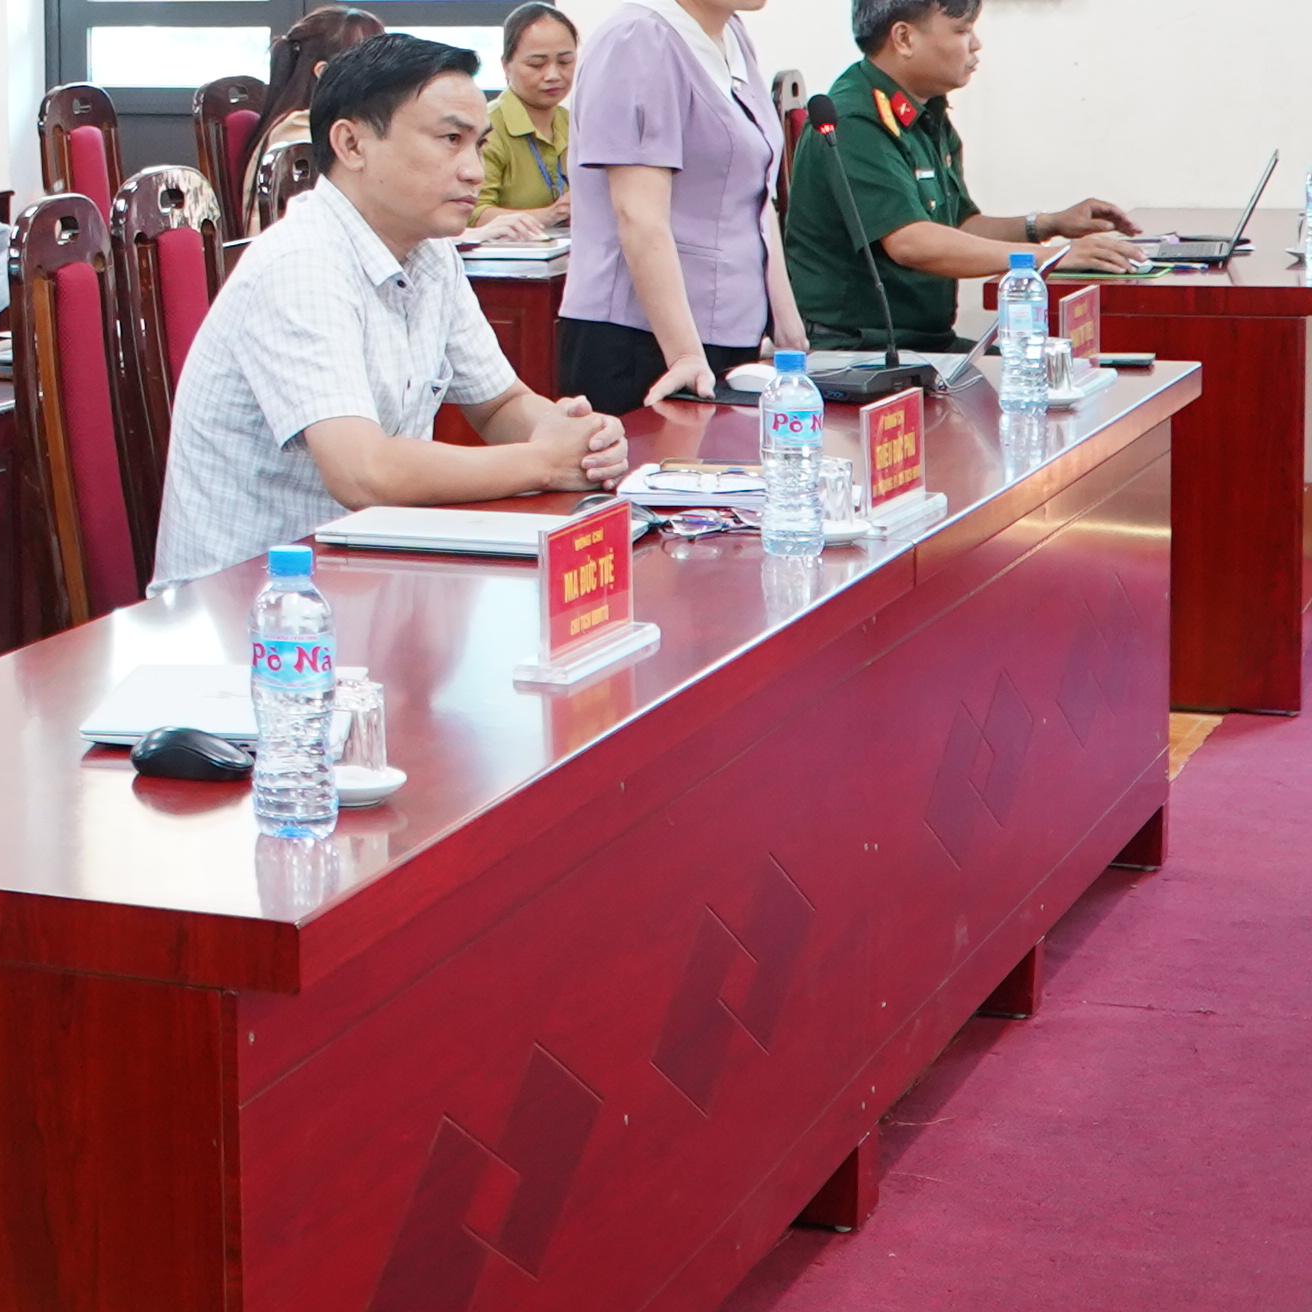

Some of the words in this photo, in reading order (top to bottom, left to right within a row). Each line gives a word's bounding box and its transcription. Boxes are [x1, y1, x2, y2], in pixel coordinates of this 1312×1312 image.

[772, 413, 803, 432] Pò
[810, 413, 824, 432] N
[564, 570, 578, 603] MA
[252, 642, 282, 672] Pò
[293, 645, 333, 674] Nà
